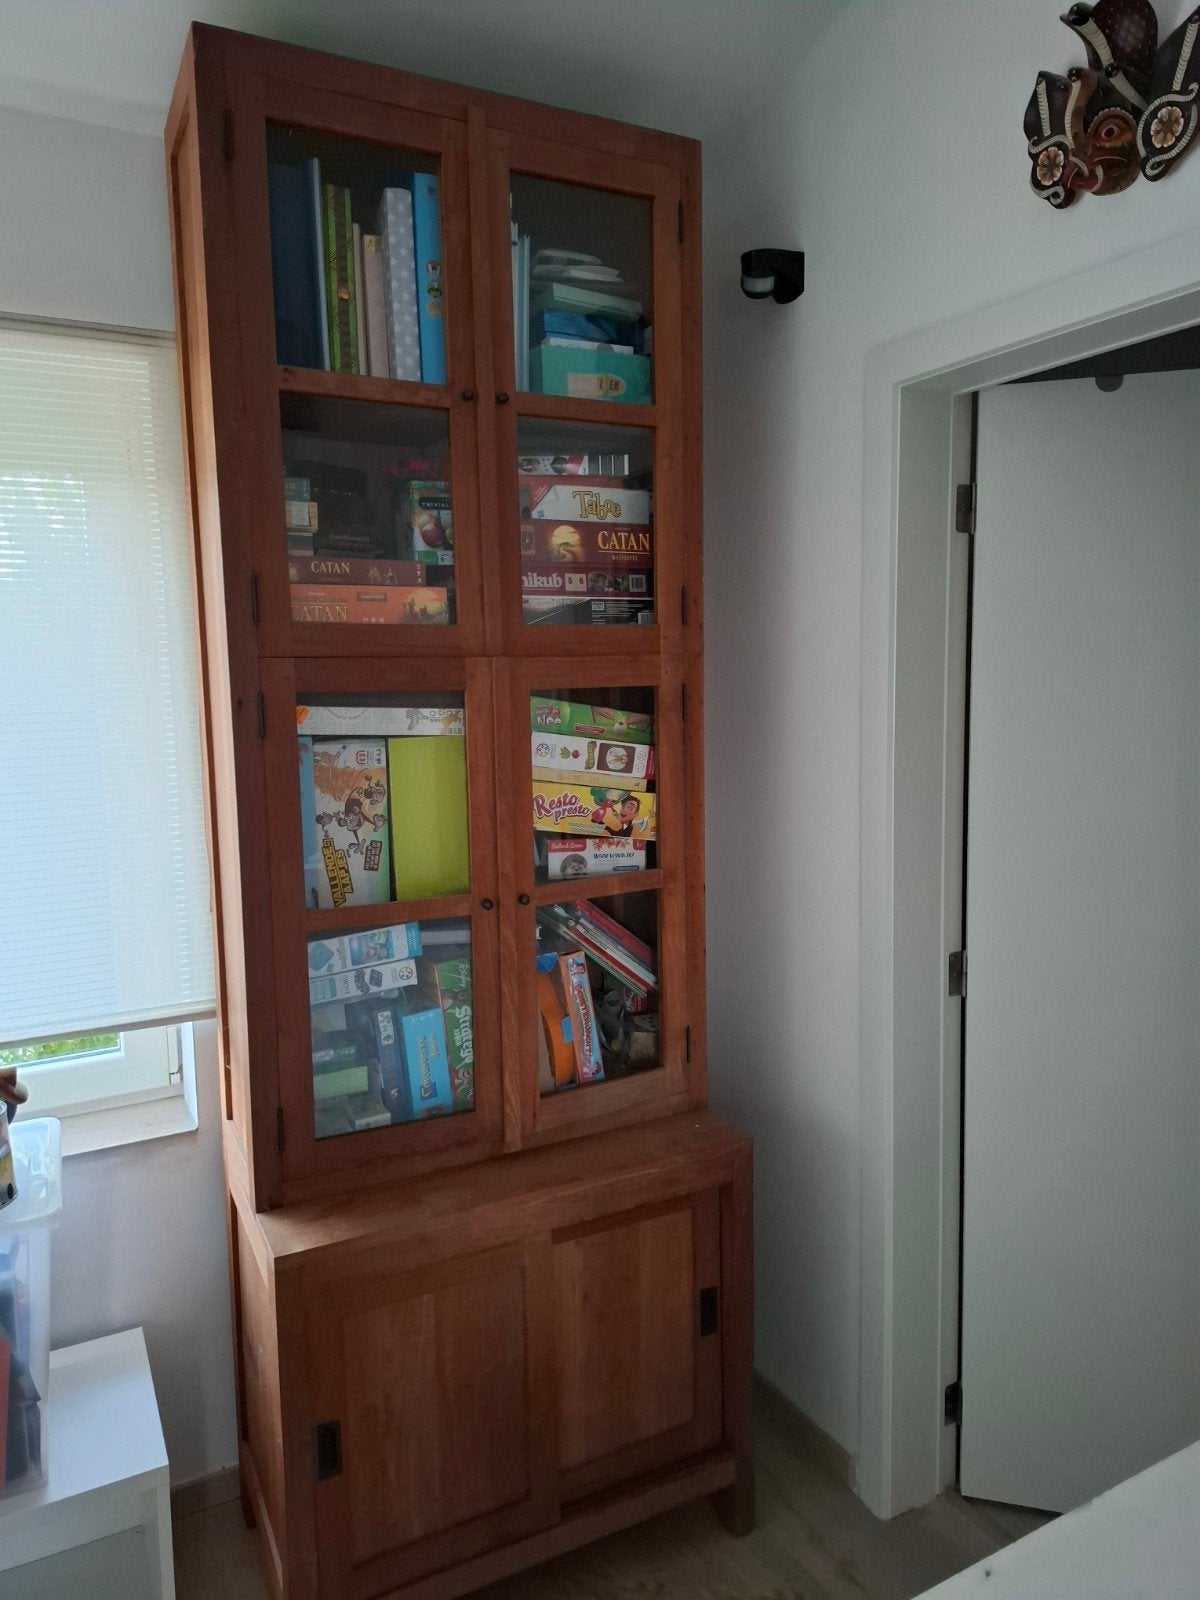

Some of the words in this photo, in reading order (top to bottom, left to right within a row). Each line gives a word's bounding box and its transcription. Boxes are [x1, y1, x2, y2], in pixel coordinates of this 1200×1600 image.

[572, 490, 622, 520] Taboe
[598, 531, 650, 551] CATAN
[310, 560, 350, 574] CATAN
[291, 605, 348, 623] CATAN
[536, 713, 562, 727] Nee
[533, 793, 578, 818] Resto
[554, 804, 590, 824] presto
[322, 846, 346, 907] VALLENDE
[336, 849, 353, 893] AAPJES
